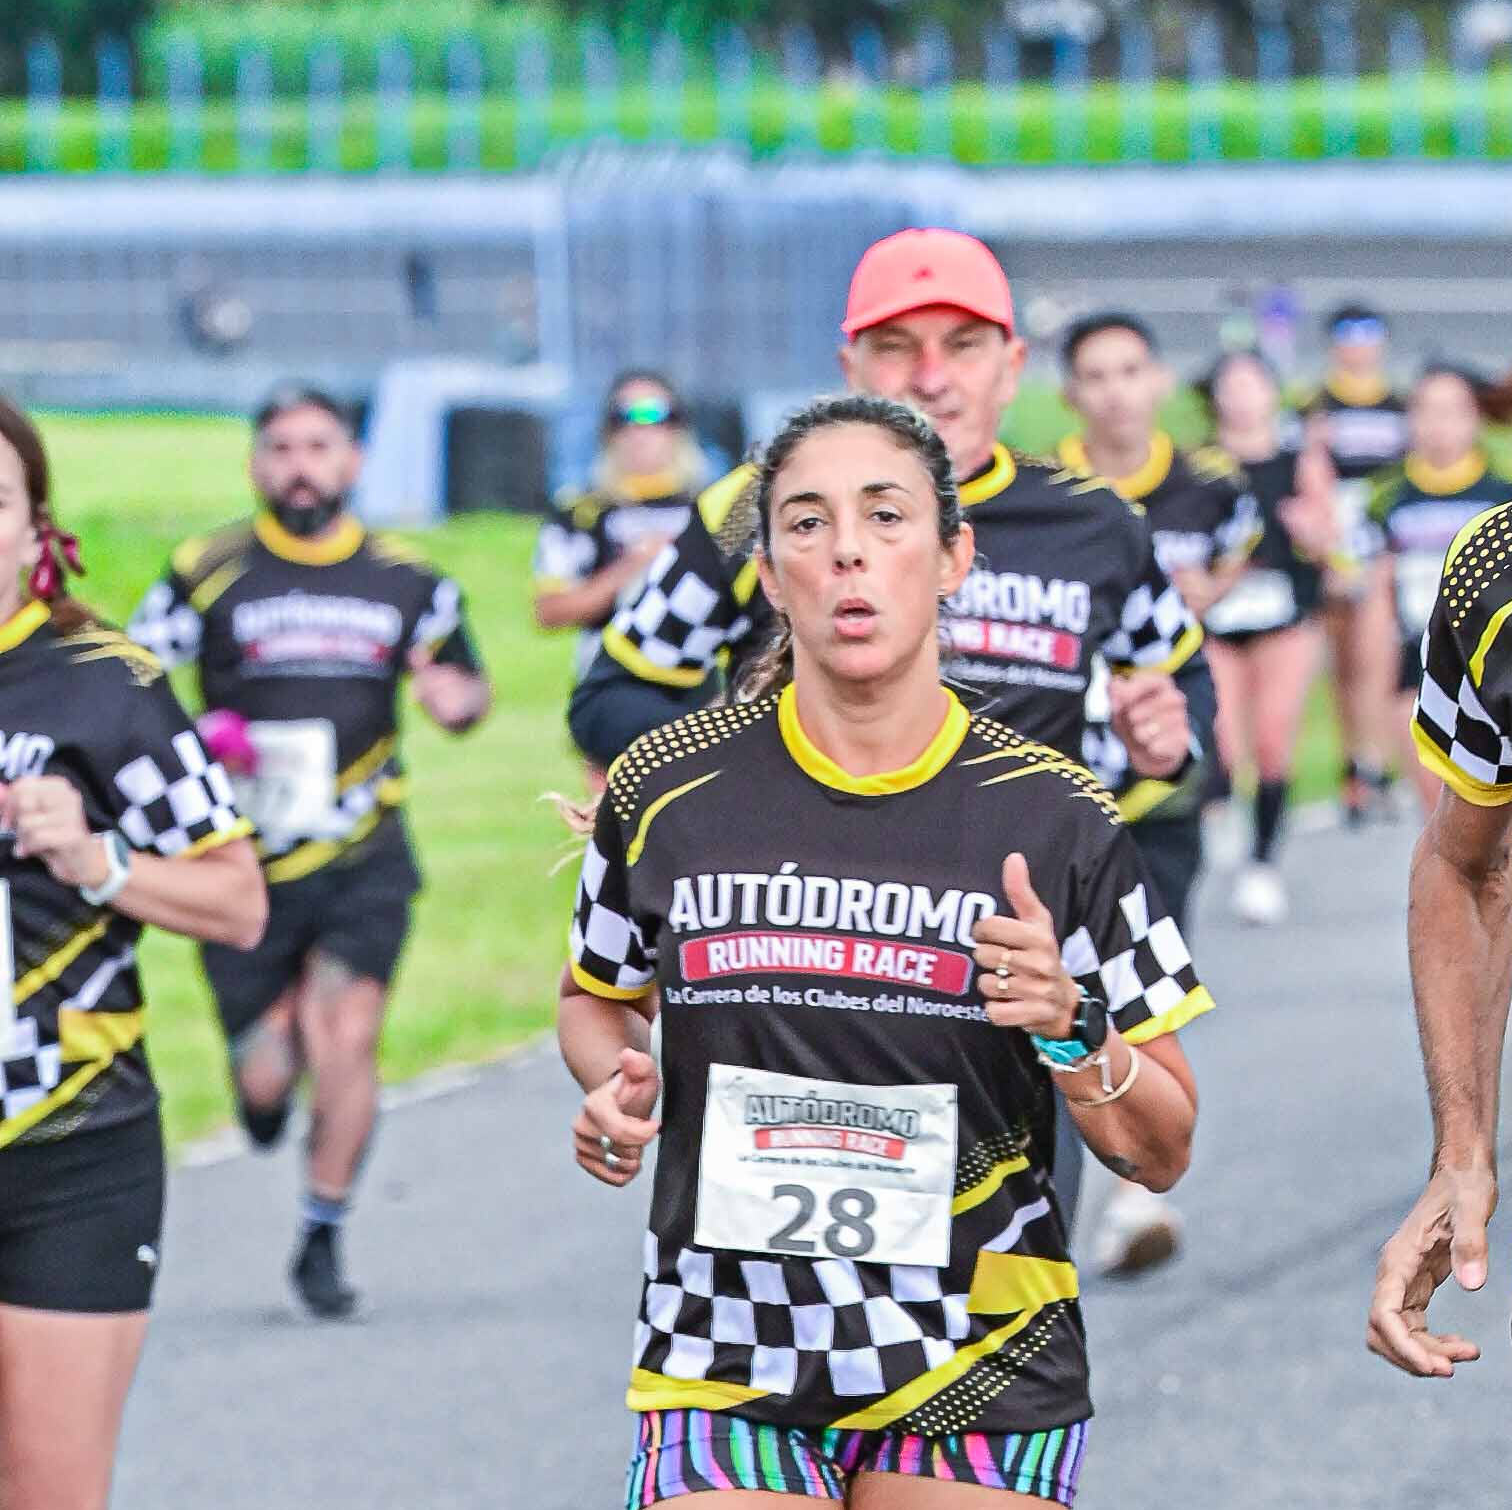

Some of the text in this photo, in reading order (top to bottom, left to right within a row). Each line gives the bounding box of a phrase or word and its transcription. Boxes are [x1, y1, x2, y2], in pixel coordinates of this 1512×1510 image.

[669, 861, 997, 949] AUTÓDROMO
[707, 938, 939, 986] RUNNING RACE
[682, 987, 742, 1005] Carrera
[744, 985, 771, 1004] de
[773, 986, 802, 1005] los
[804, 988, 871, 1011] Clubes
[872, 993, 905, 1014] del
[744, 1090, 921, 1139] AUTÓDROMO
[768, 1183, 877, 1258] 28
